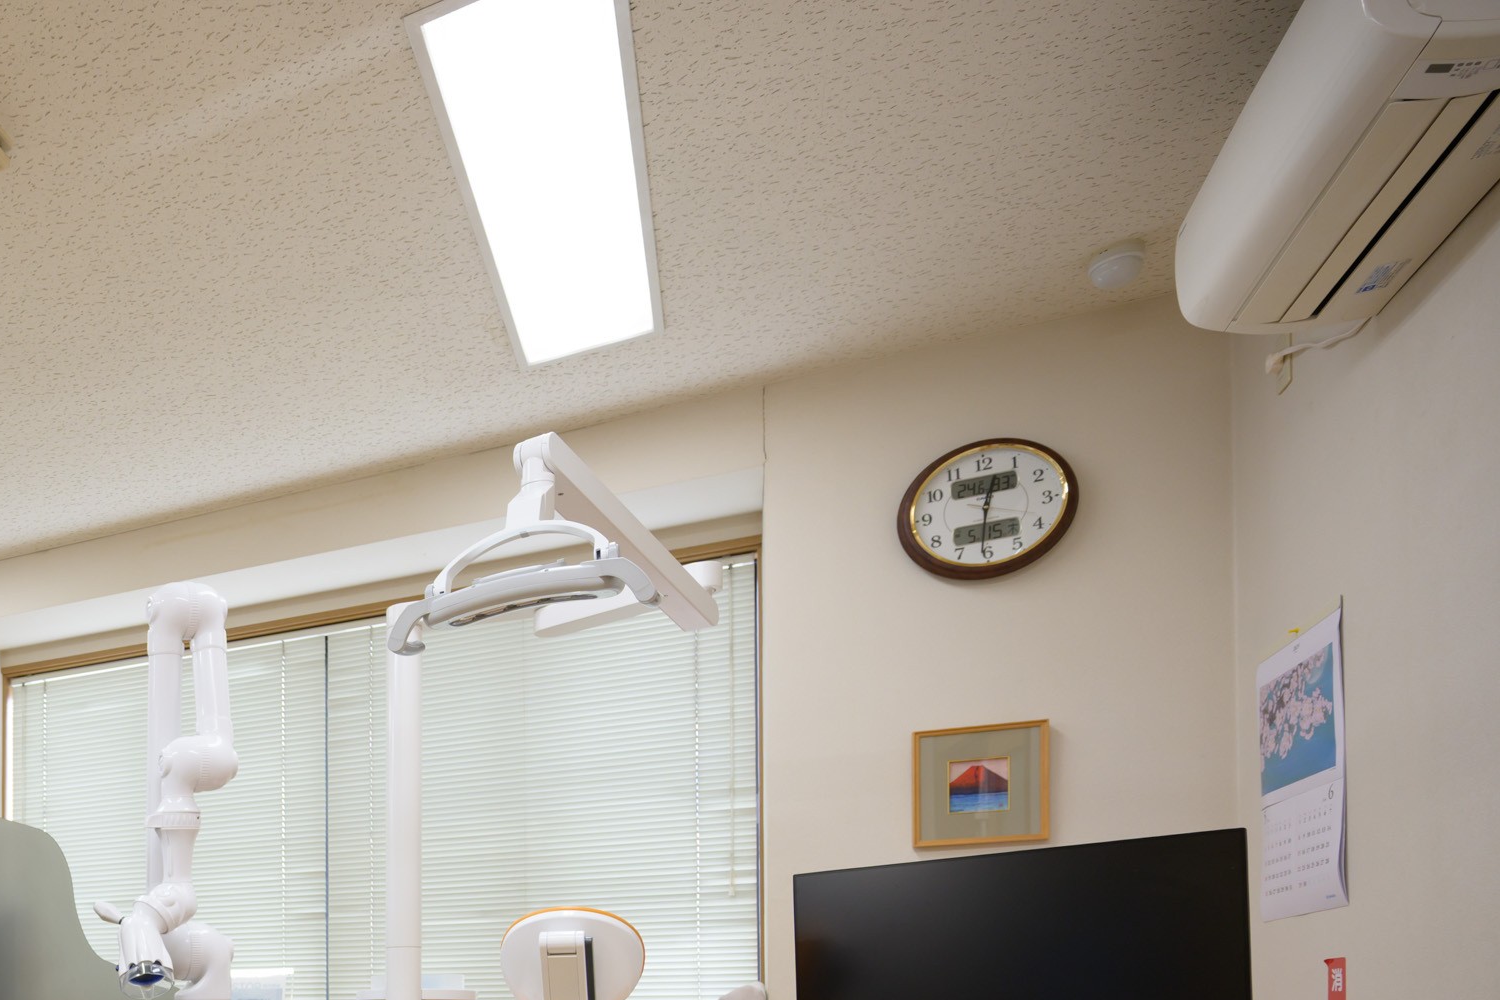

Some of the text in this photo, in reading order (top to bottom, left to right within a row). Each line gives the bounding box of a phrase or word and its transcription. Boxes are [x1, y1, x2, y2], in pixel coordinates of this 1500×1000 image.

[975, 457, 993, 472] 12
[1012, 456, 1019, 468] 1
[947, 468, 961, 482] 11
[1033, 469, 1044, 483] 2
[927, 489, 943, 503] 10
[1042, 490, 1053, 504] 3
[922, 514, 932, 527] 9
[1033, 516, 1044, 530] 4
[988, 523, 1002, 540] 15
[931, 535, 942, 548] 8
[1012, 537, 1023, 551] 5
[954, 547, 965, 560] 7
[983, 546, 994, 559] 6
